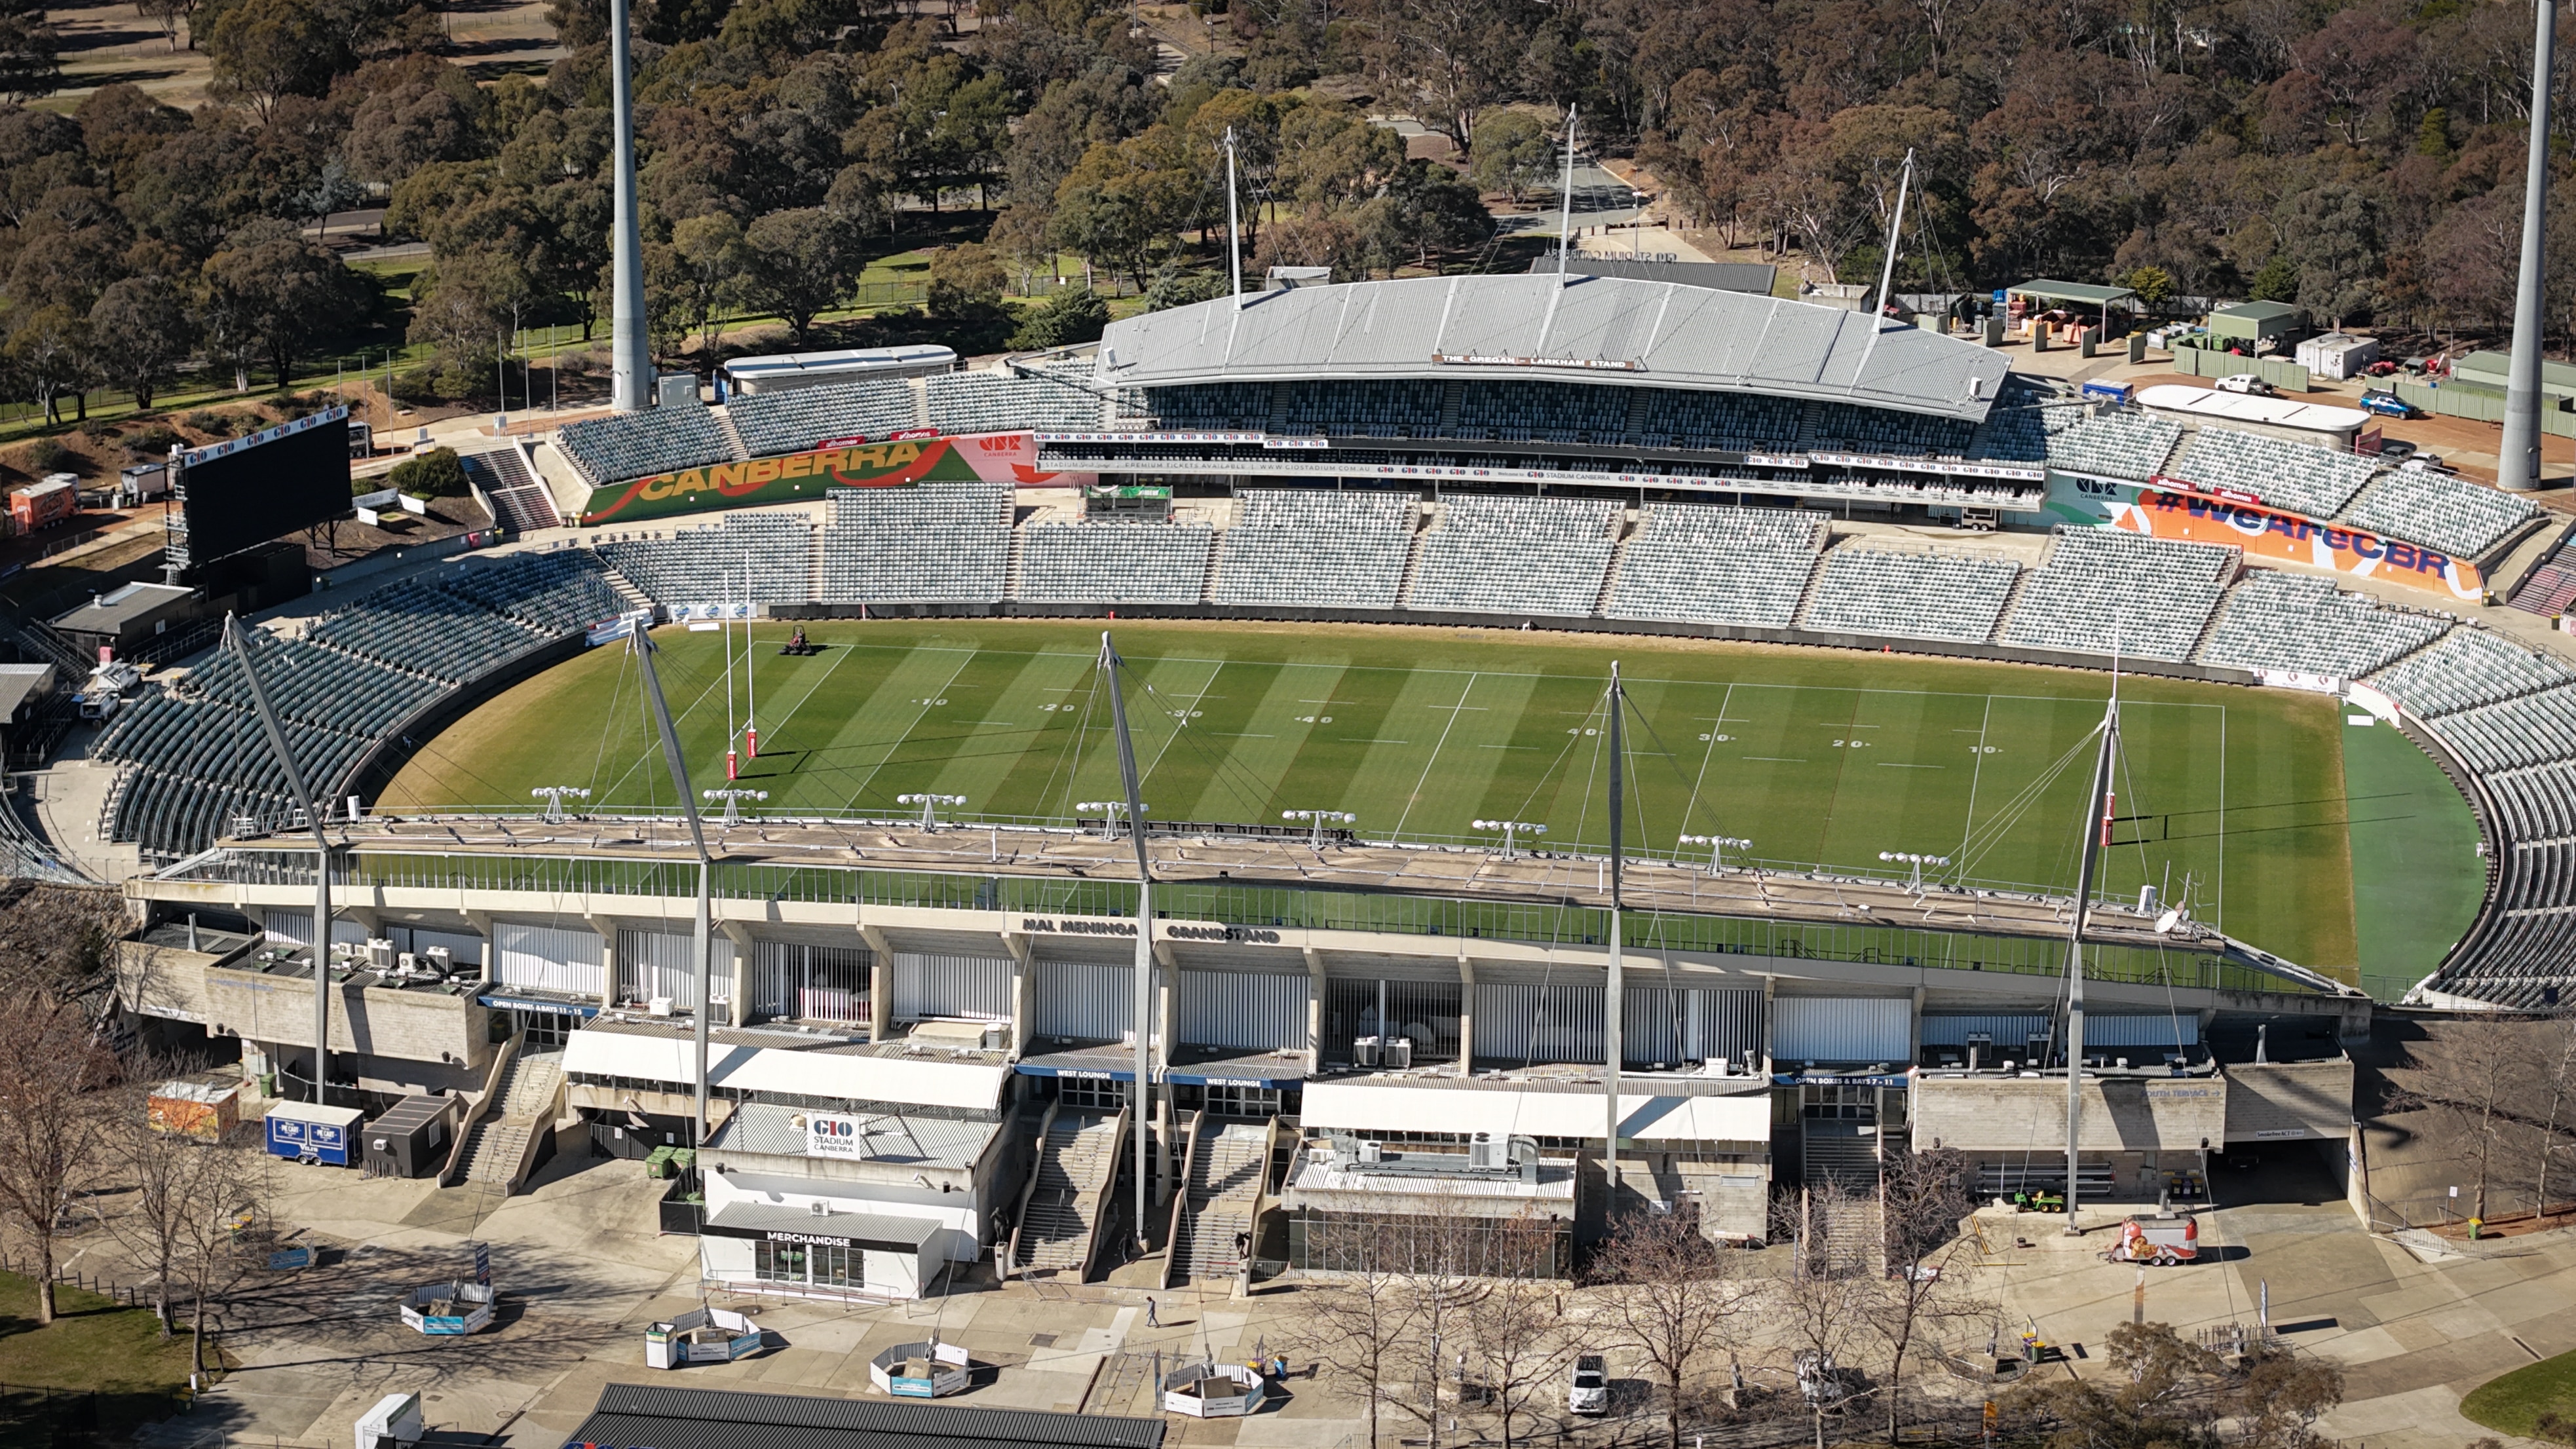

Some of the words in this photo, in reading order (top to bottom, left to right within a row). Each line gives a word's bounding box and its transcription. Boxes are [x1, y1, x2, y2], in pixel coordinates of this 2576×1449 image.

[1469, 356, 1515, 364] GREGAN
[1530, 358, 1585, 366] LARKHAM
[190, 451, 207, 464] GIO
[218, 442, 235, 456] GIO
[247, 433, 264, 446] GIO
[274, 424, 290, 438] GIO
[300, 416, 316, 429] GIO
[326, 407, 343, 421] GIO
[639, 443, 922, 500] CANBERRA
[1023, 918, 1057, 932] MAL
[1060, 920, 1138, 936] MENINGA
[1167, 925, 1281, 944] GRANDSTAND
[513, 1002, 535, 1011] BOXES
[1078, 1070, 1110, 1079] LOUNGE
[1228, 1079, 1261, 1087] LOUNGE
[814, 1120, 853, 1137] GIO
[814, 1136, 854, 1146] STADIUM
[814, 1144, 854, 1153] CANBERRA
[767, 1232, 850, 1247] MERCHANDISE
